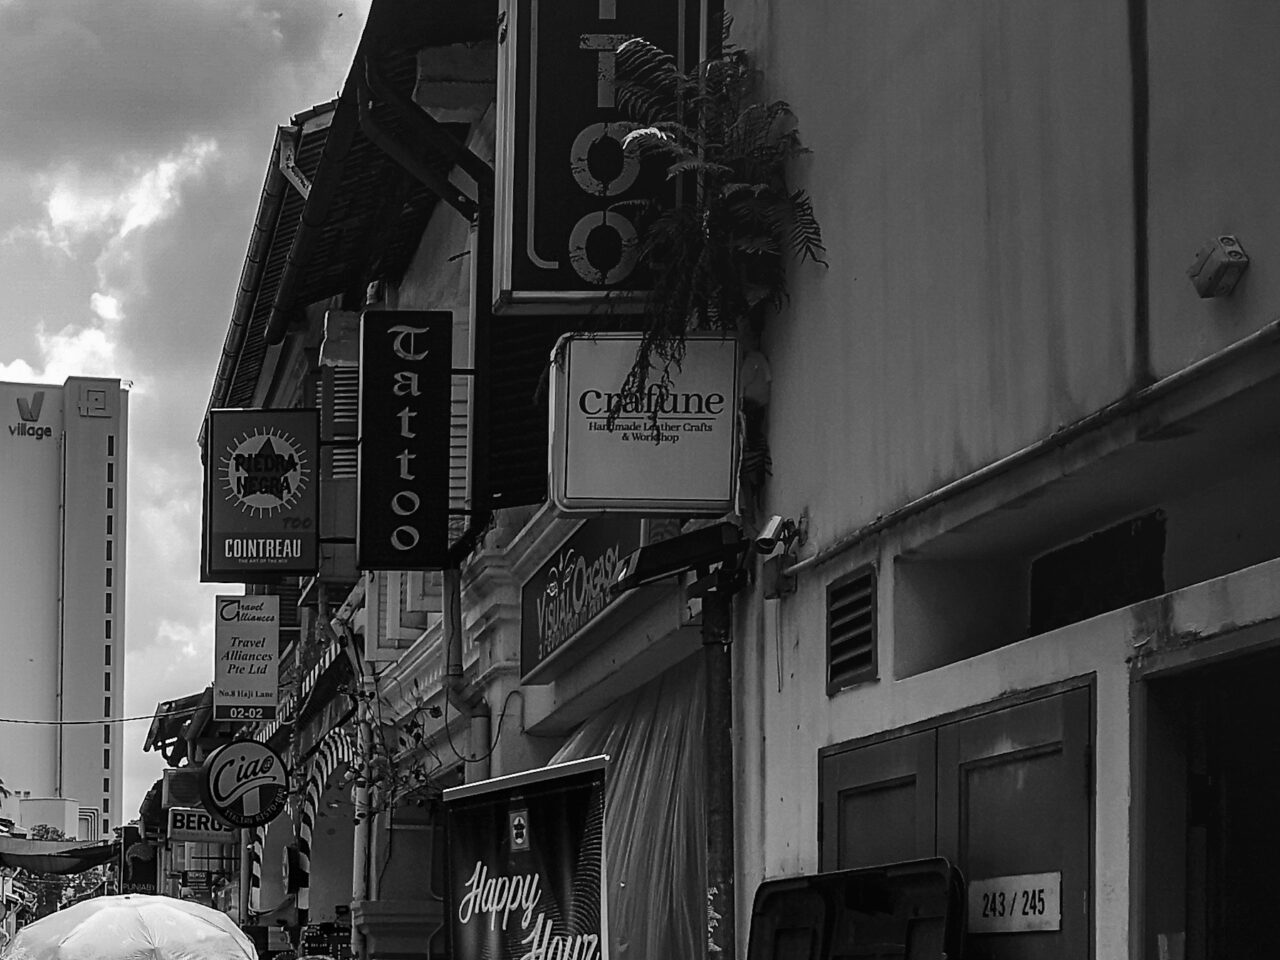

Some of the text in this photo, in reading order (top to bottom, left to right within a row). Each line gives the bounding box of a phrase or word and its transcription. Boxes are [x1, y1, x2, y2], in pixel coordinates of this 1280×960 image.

[569, 0, 645, 285] TOO
[8, 422, 52, 441] village
[644, 422, 681, 431] Lther
[683, 422, 713, 432] Crafts
[387, 325, 429, 550] Tattoo
[622, 433, 679, 444] & Workhop
[233, 453, 299, 473] PIEDRA
[236, 475, 292, 501] NEGRA
[282, 516, 313, 529] TOO
[224, 538, 301, 558] COINTREAU
[231, 636, 266, 648] Travel
[221, 650, 273, 661] Alliances
[227, 663, 268, 675] Pte Ltd
[237, 689, 254, 699] Haji
[255, 689, 274, 698] Lane
[230, 707, 263, 718] 02-02
[213, 754, 276, 804] Ciao
[172, 812, 236, 832] BERG
[460, 860, 542, 931] Happy
[982, 892, 1006, 918] 243
[1022, 889, 1046, 916] 245
